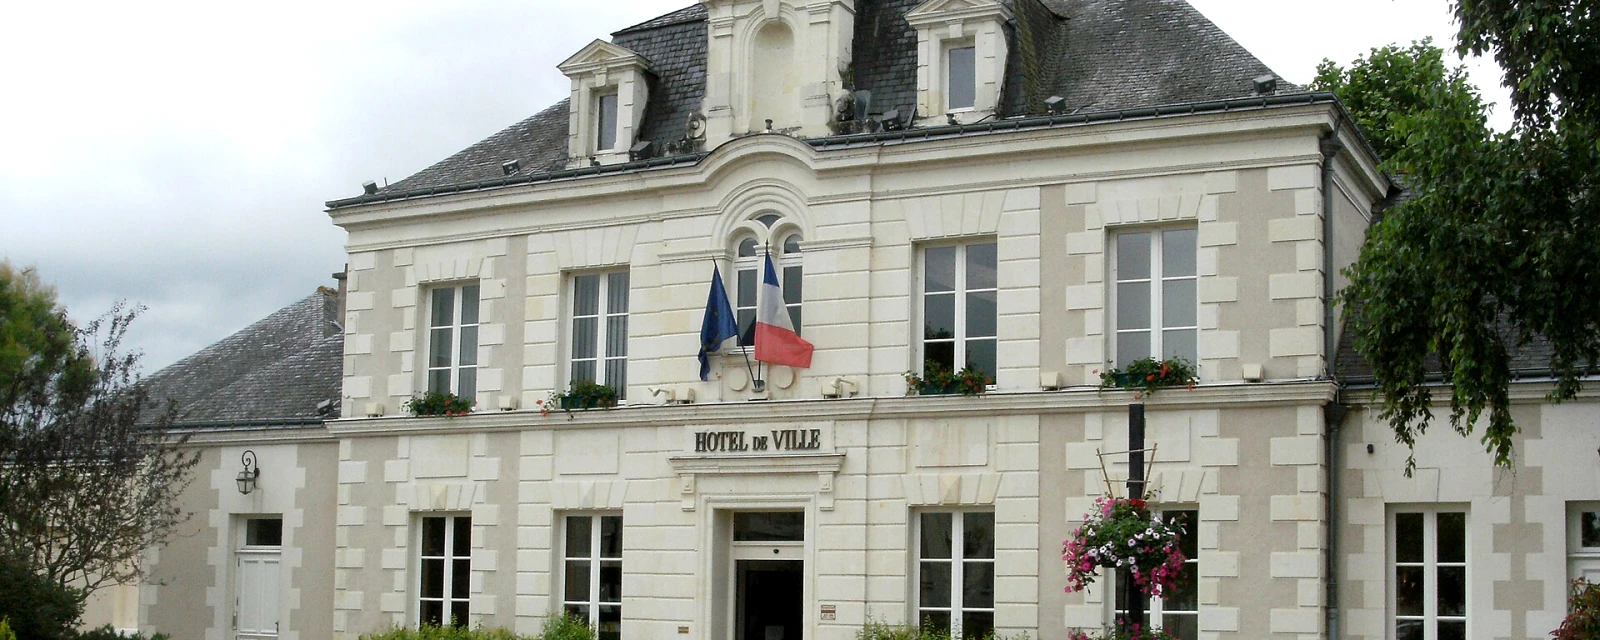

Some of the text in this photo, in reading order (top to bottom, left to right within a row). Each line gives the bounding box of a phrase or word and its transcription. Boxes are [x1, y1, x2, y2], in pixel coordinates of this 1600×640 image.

[694, 429, 821, 452] HOTEL DE VILLE
